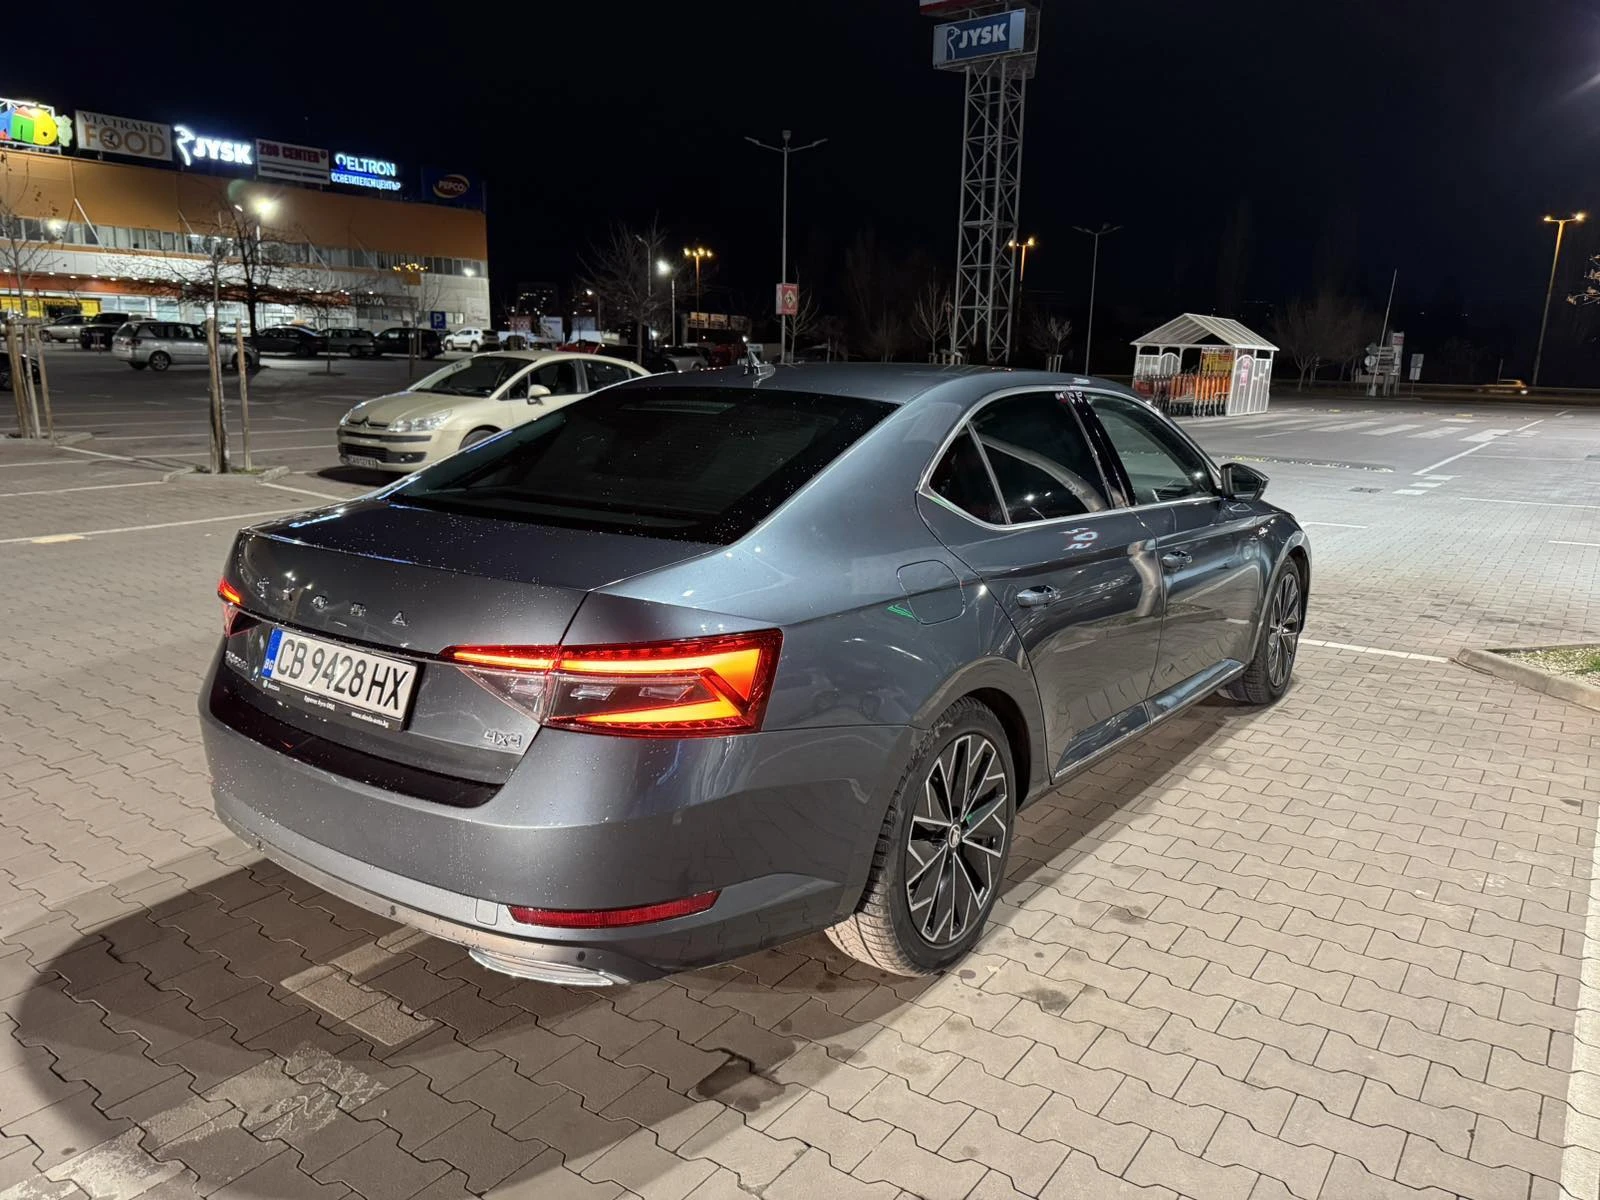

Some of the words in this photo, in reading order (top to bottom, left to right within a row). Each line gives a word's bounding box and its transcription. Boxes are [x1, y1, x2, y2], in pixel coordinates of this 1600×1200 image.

[959, 23, 1007, 48] JYSK
[82, 113, 107, 126] VIA
[110, 119, 164, 135] TRAKIA
[84, 124, 166, 157] FOOD
[193, 137, 253, 165] JYSK
[433, 313, 443, 326] P
[263, 658, 275, 671] BG
[276, 639, 307, 680] CB
[309, 648, 368, 698] 9428
[365, 663, 409, 710] HX
[483, 729, 522, 748] 4x4
